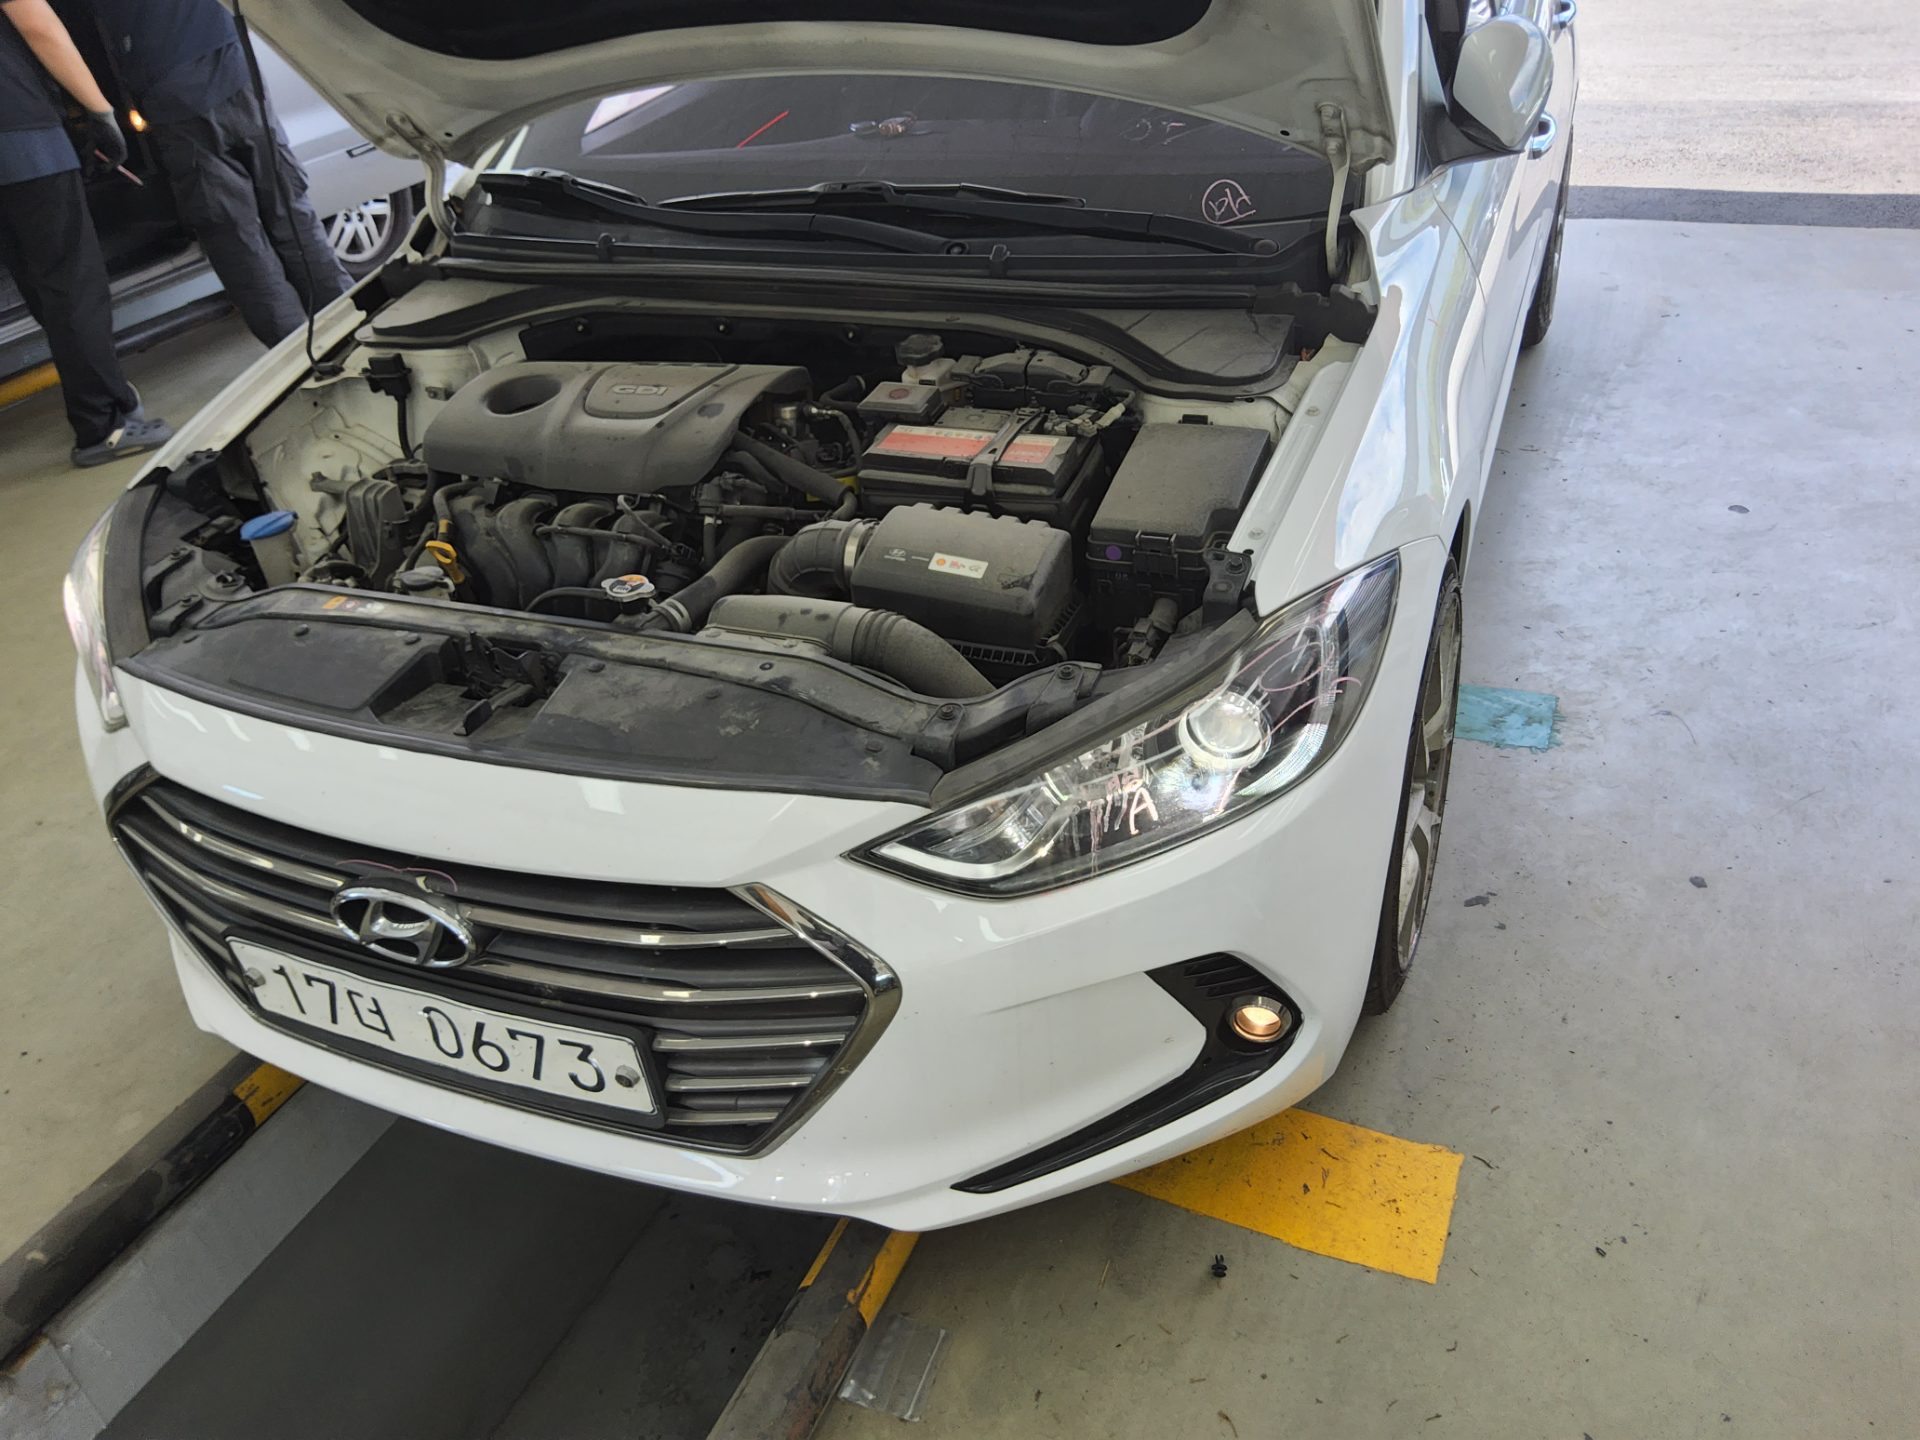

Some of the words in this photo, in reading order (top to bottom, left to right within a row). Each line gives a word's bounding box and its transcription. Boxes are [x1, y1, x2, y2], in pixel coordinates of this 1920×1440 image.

[611, 384, 669, 397] GDI
[272, 964, 396, 1042] 17더
[420, 1005, 606, 1093] 0673
